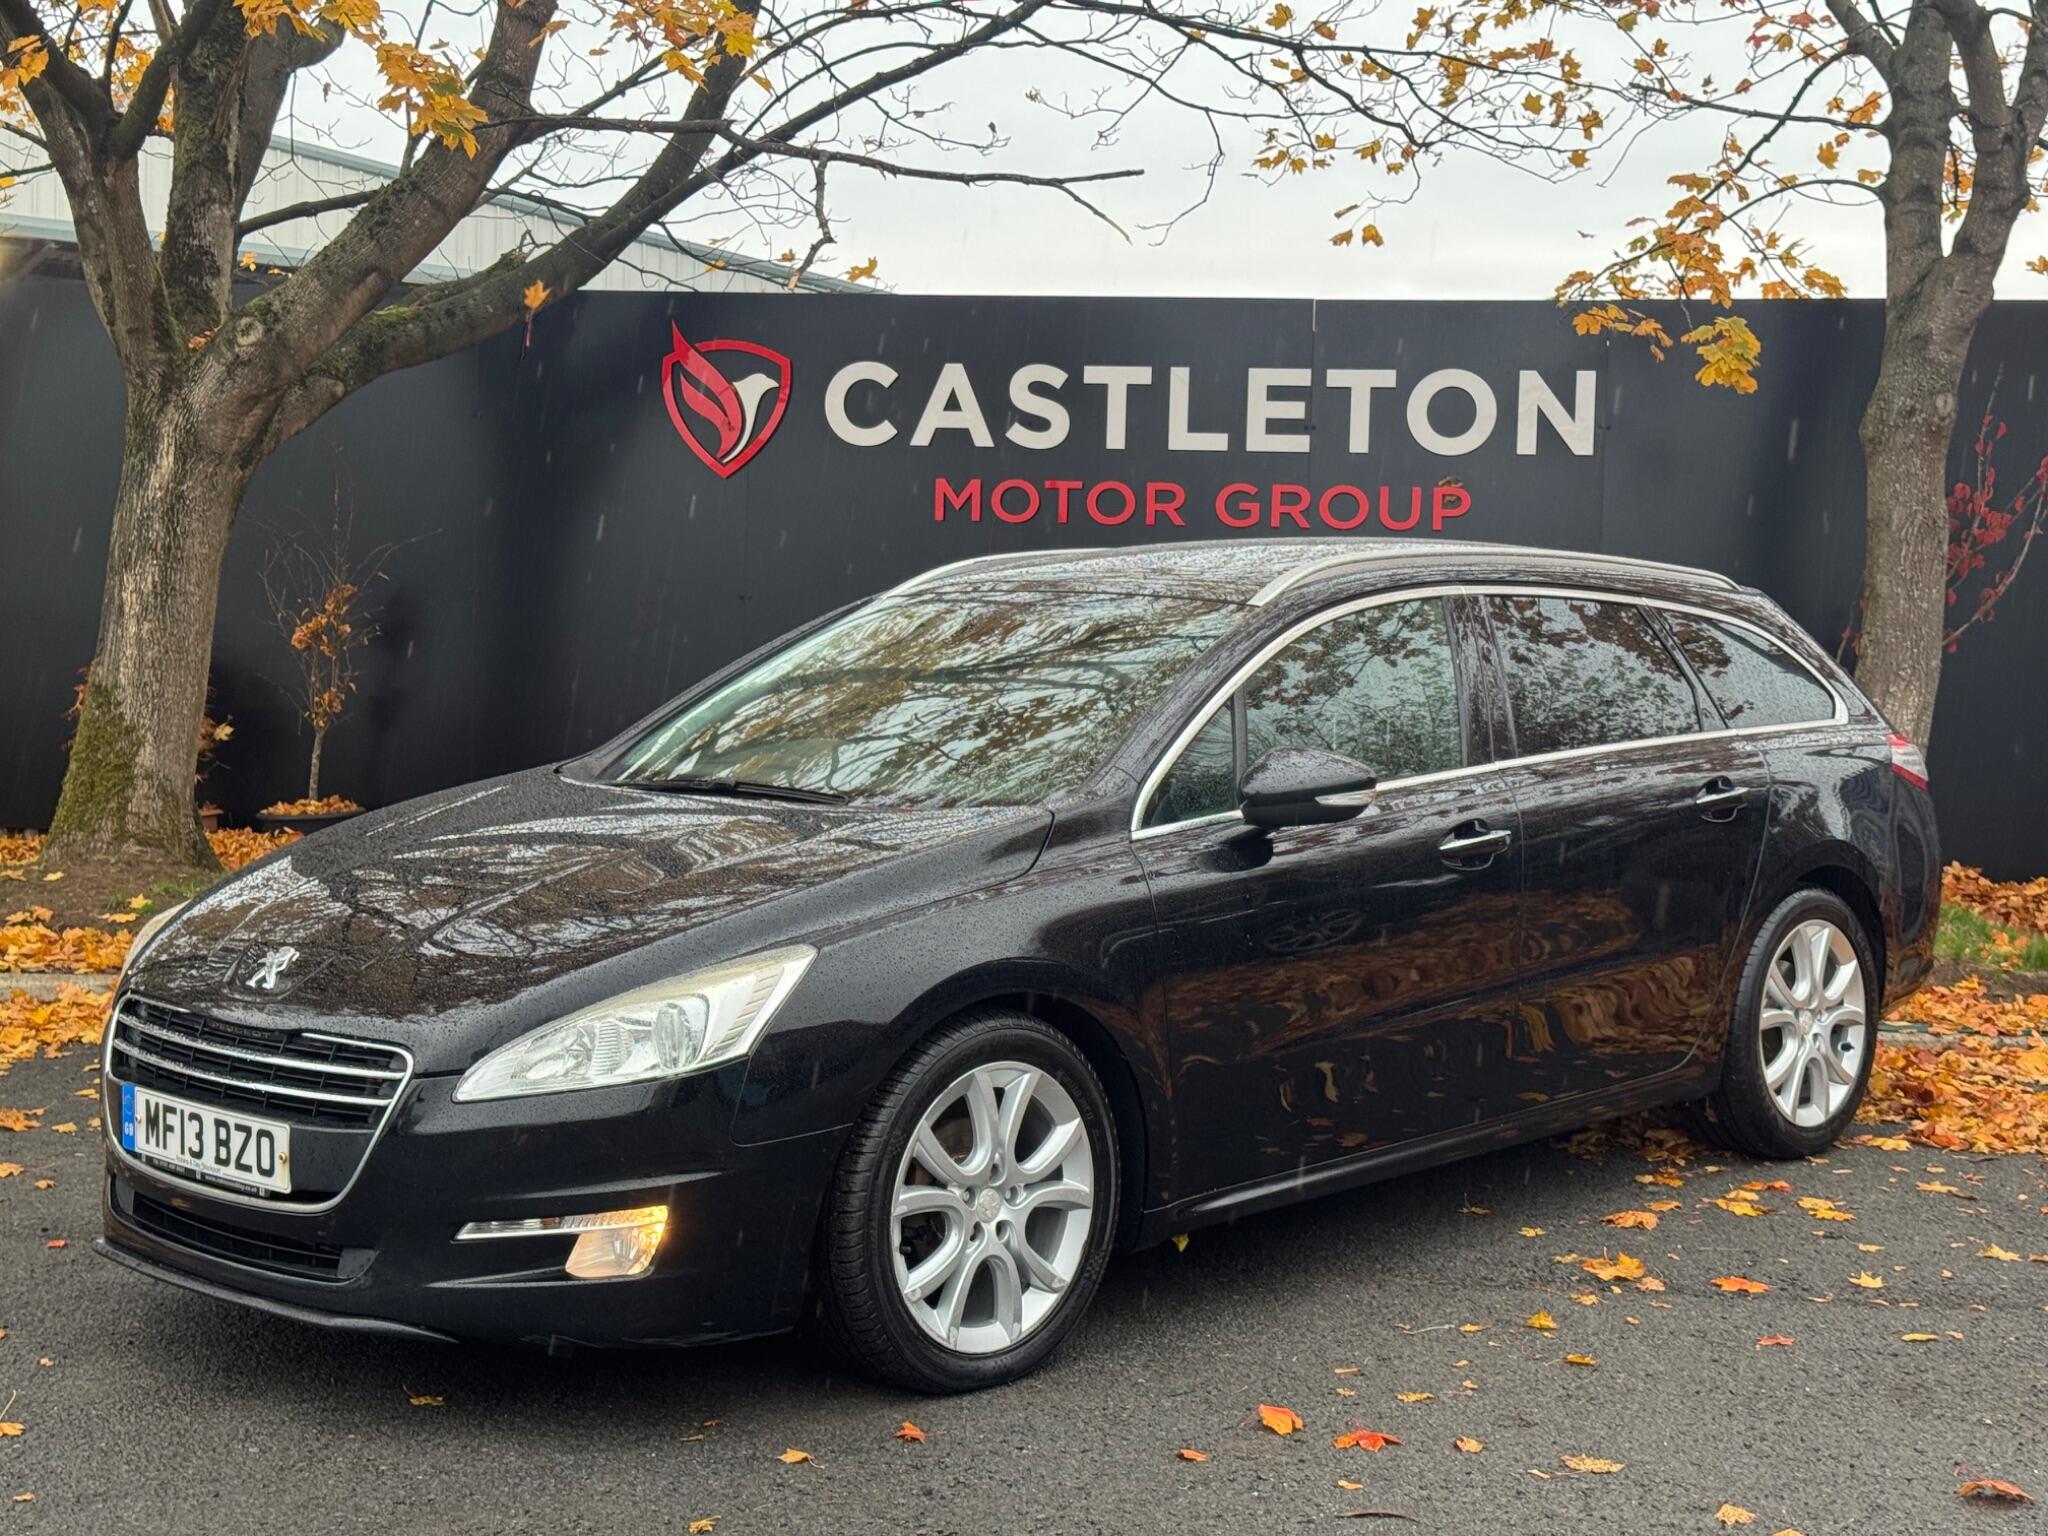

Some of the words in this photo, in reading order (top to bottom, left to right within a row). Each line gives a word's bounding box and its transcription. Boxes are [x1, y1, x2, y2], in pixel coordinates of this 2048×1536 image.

[824, 361, 1597, 456] CASTLETON
[934, 477, 1186, 527] MOTOR
[1215, 482, 1473, 531] GROUP
[145, 1099, 204, 1160] MF13
[214, 1119, 275, 1177] BZO
